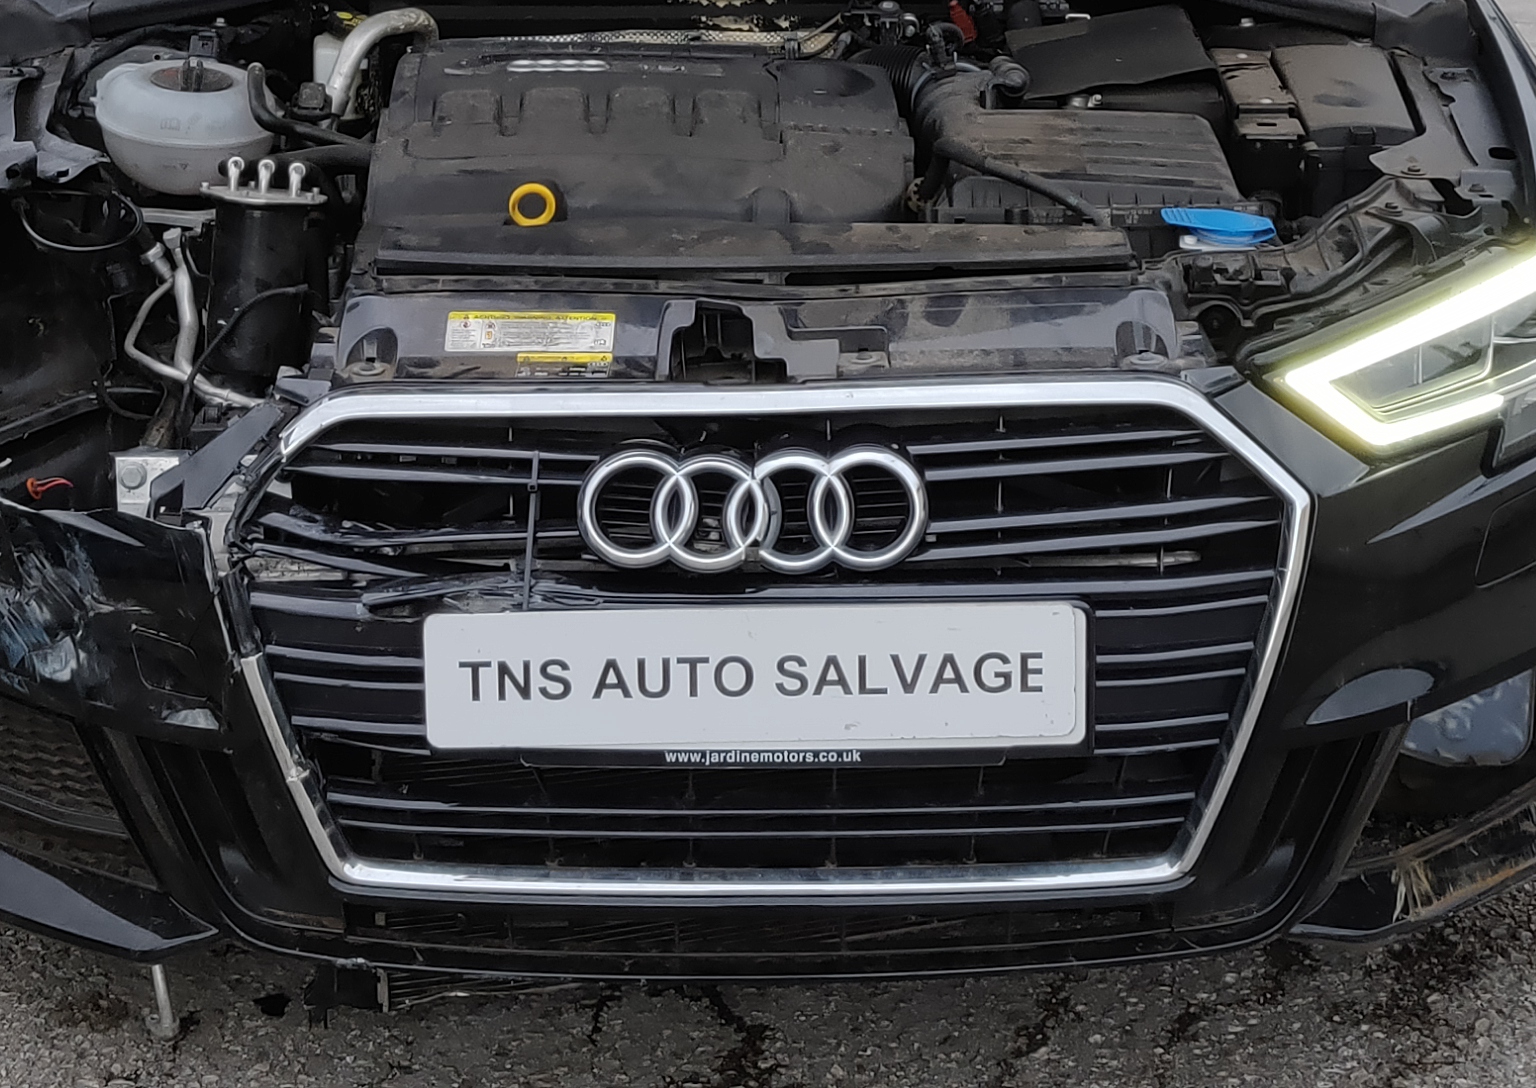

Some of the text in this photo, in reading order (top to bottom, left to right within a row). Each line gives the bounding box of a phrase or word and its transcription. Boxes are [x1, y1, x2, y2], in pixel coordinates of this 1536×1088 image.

[458, 651, 1044, 702] TNS AUTO SALVAGE
[665, 749, 862, 766] www.jardinemotors.co.uk
